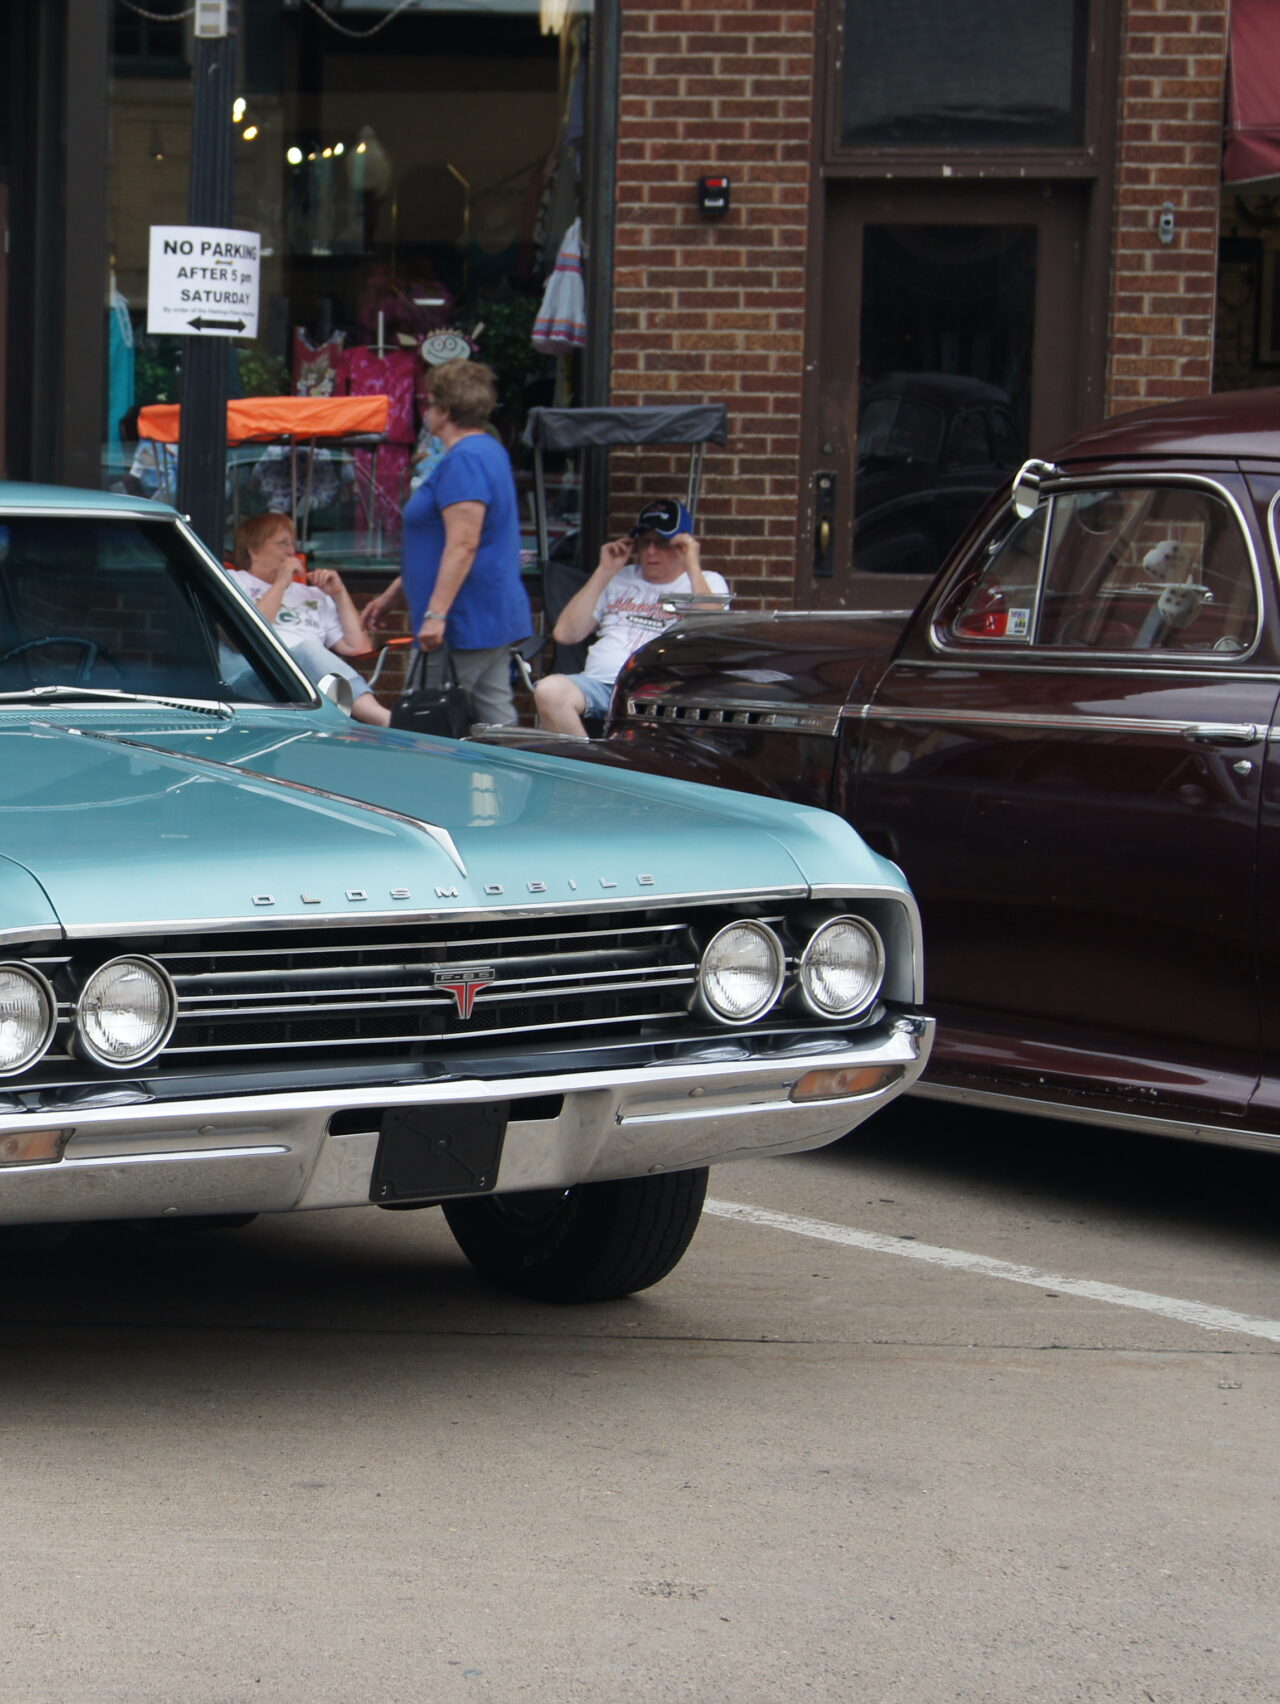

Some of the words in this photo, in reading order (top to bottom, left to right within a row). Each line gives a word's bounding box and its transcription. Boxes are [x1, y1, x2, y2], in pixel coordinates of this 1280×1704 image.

[163, 240, 193, 255] NO
[200, 241, 257, 260] PARKING
[177, 267, 228, 281] AFTER
[231, 269, 238, 282] 5
[241, 273, 252, 284] pm
[180, 289, 250, 304] SATURDAY
[252, 873, 656, 905] OLDSMOBILE
